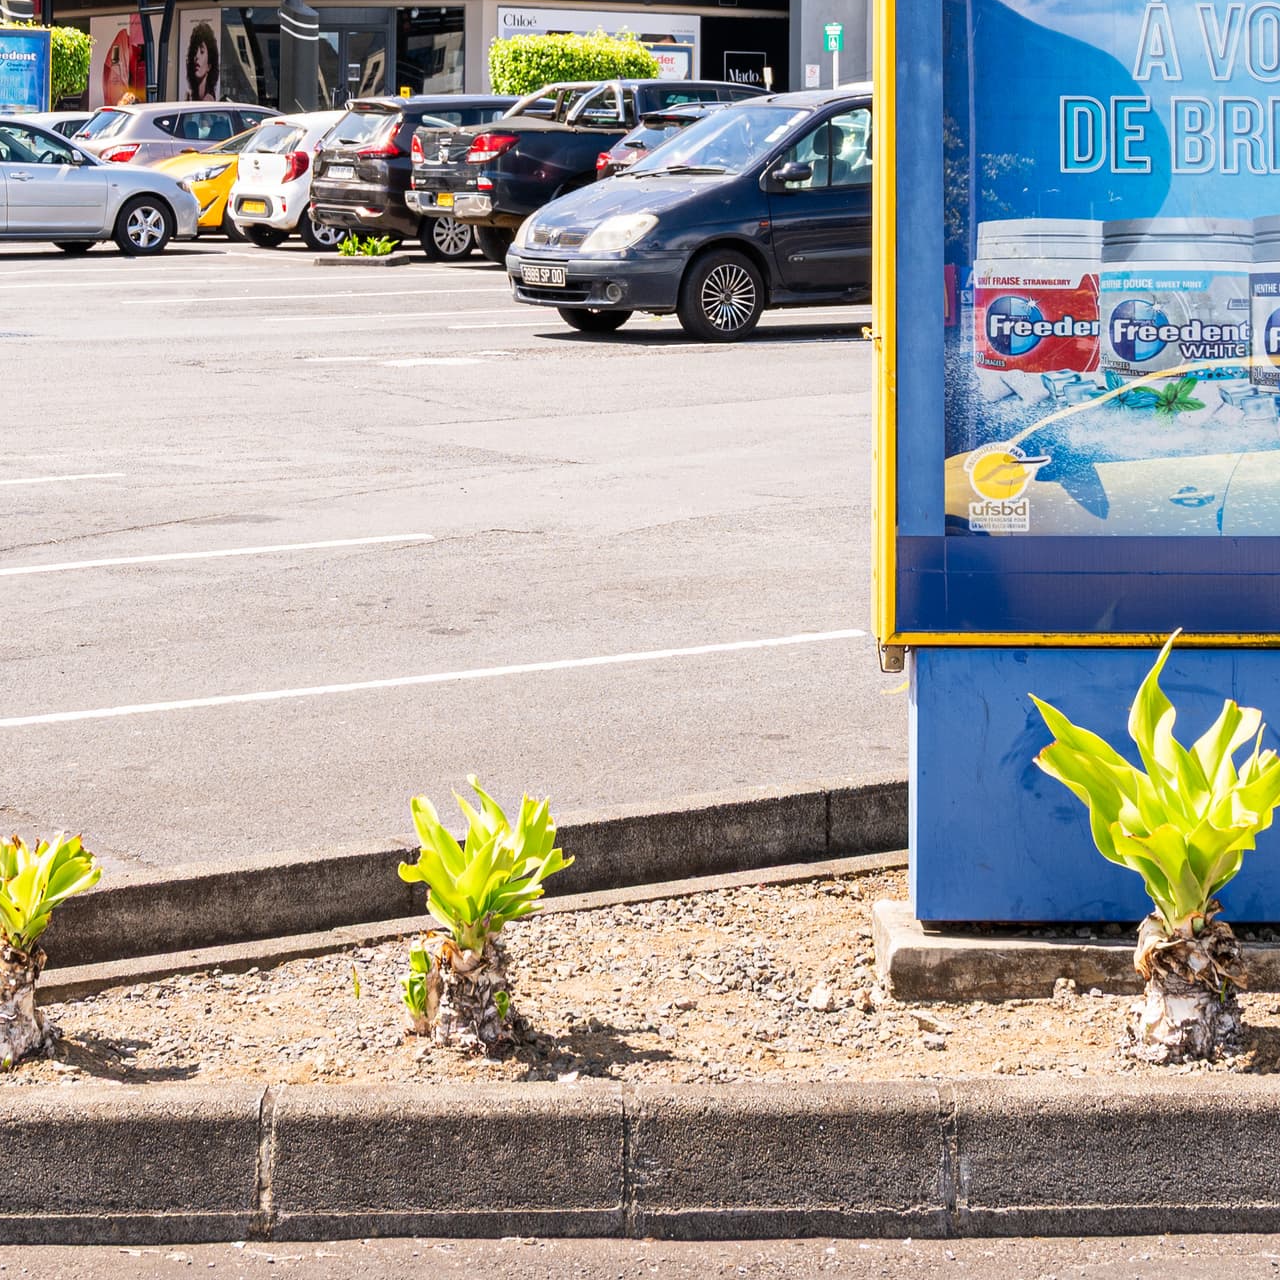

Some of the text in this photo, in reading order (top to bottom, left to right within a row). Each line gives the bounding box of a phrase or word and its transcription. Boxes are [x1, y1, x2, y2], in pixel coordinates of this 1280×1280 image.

[503, 13, 538, 29] Chloé
[1058, 94, 1153, 175] DE
[992, 276, 1020, 286] FRAISE
[1022, 278, 1072, 286] STRAWBERRY
[1123, 278, 1153, 289] DOUCE
[1180, 343, 1246, 358] WHITE
[1009, 447, 1024, 459] PAR
[972, 501, 1027, 517] ufsbd
